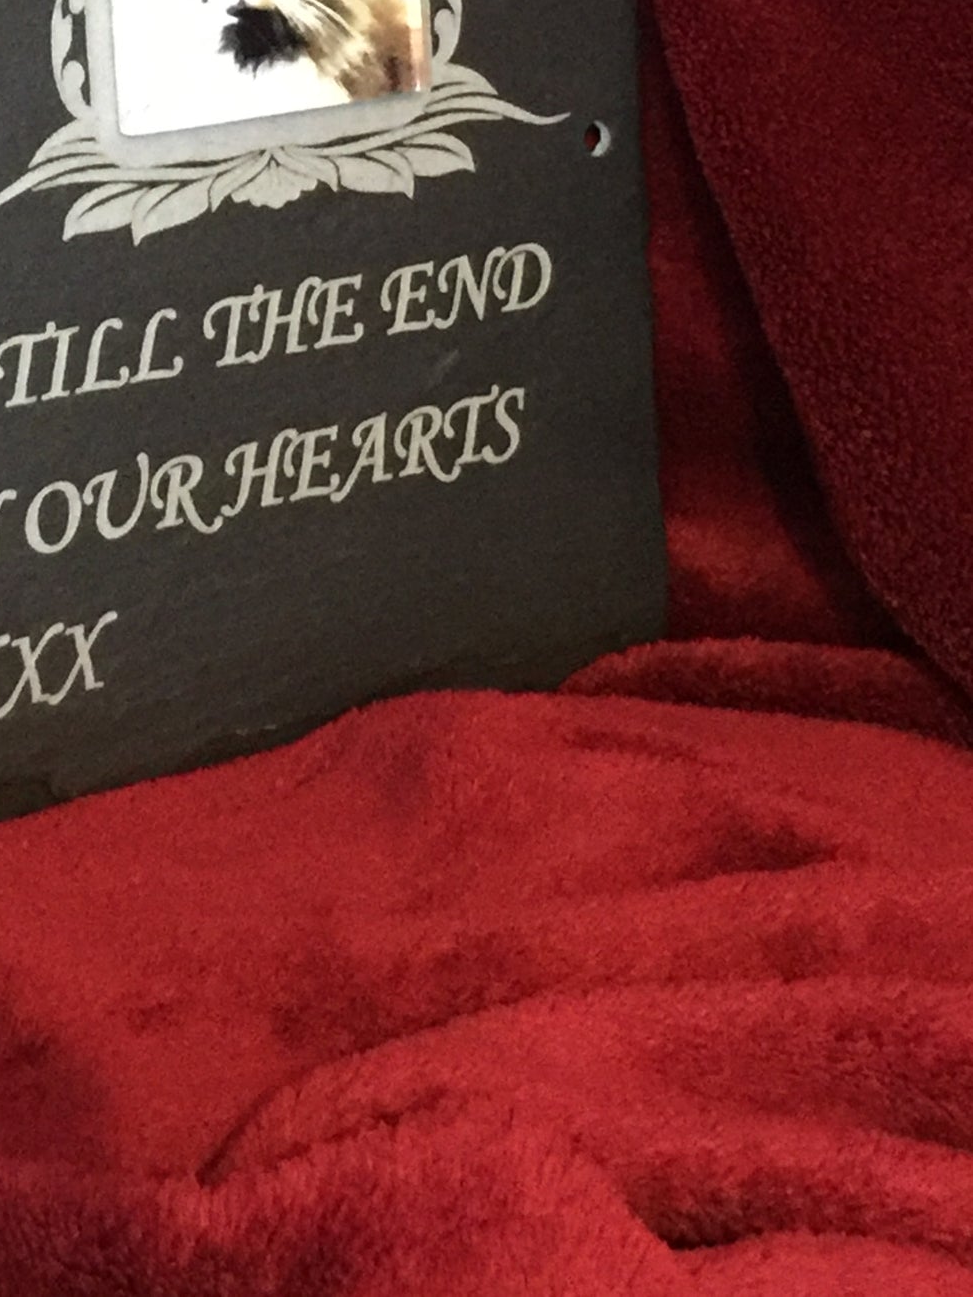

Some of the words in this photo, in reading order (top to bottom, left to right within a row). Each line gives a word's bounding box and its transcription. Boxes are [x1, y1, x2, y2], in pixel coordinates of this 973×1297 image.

[202, 273, 364, 368] THE
[380, 242, 552, 336] END
[24, 451, 224, 555] OUR
[221, 384, 525, 517] HEARTS
